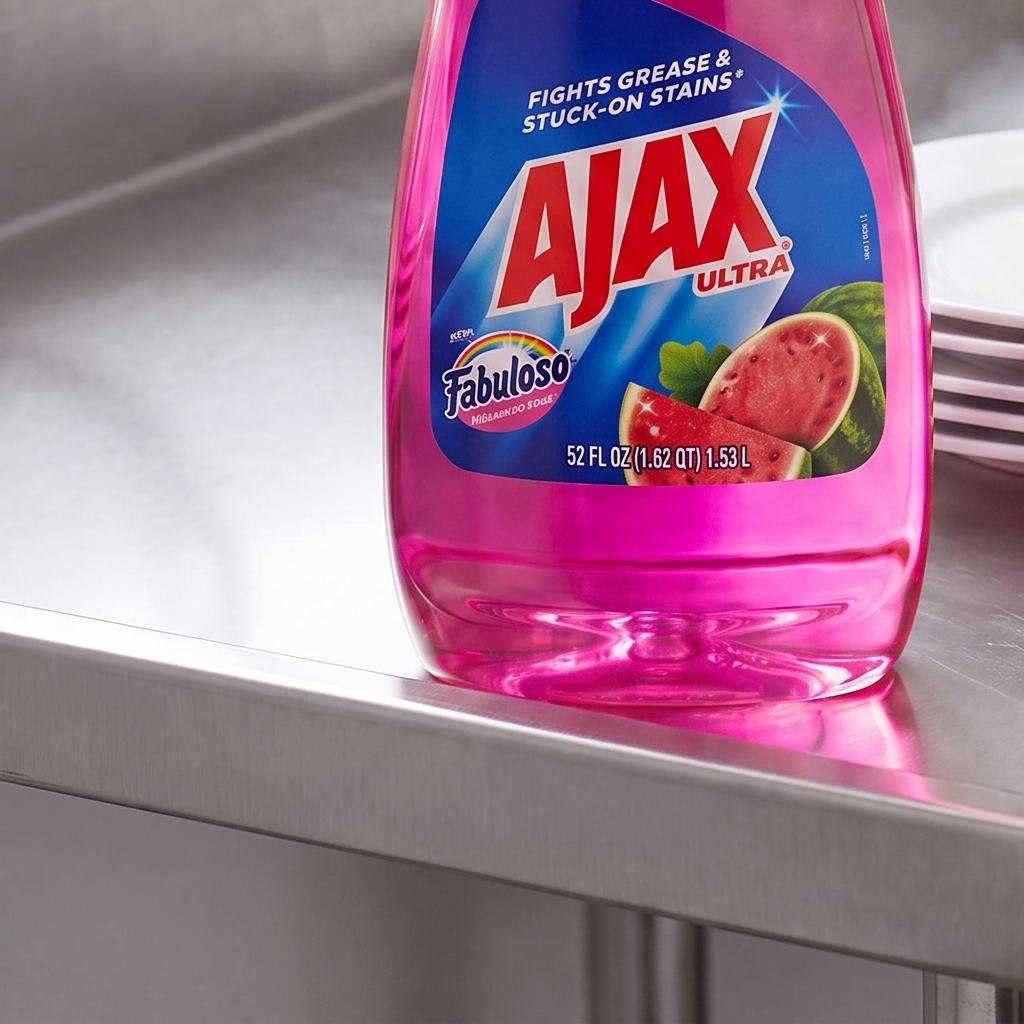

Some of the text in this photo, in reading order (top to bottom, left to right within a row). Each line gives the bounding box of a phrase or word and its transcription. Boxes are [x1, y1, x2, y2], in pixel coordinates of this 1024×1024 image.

[527, 48, 731, 110] FIGHTS GREASE &
[522, 94, 644, 133] STUCK-ON
[496, 111, 778, 330] AJAX
[697, 253, 790, 293] ULTRA
[443, 353, 570, 418] Fabuloso
[567, 445, 751, 473] 52 FL OZ (1.62 QT) 1.53 L
